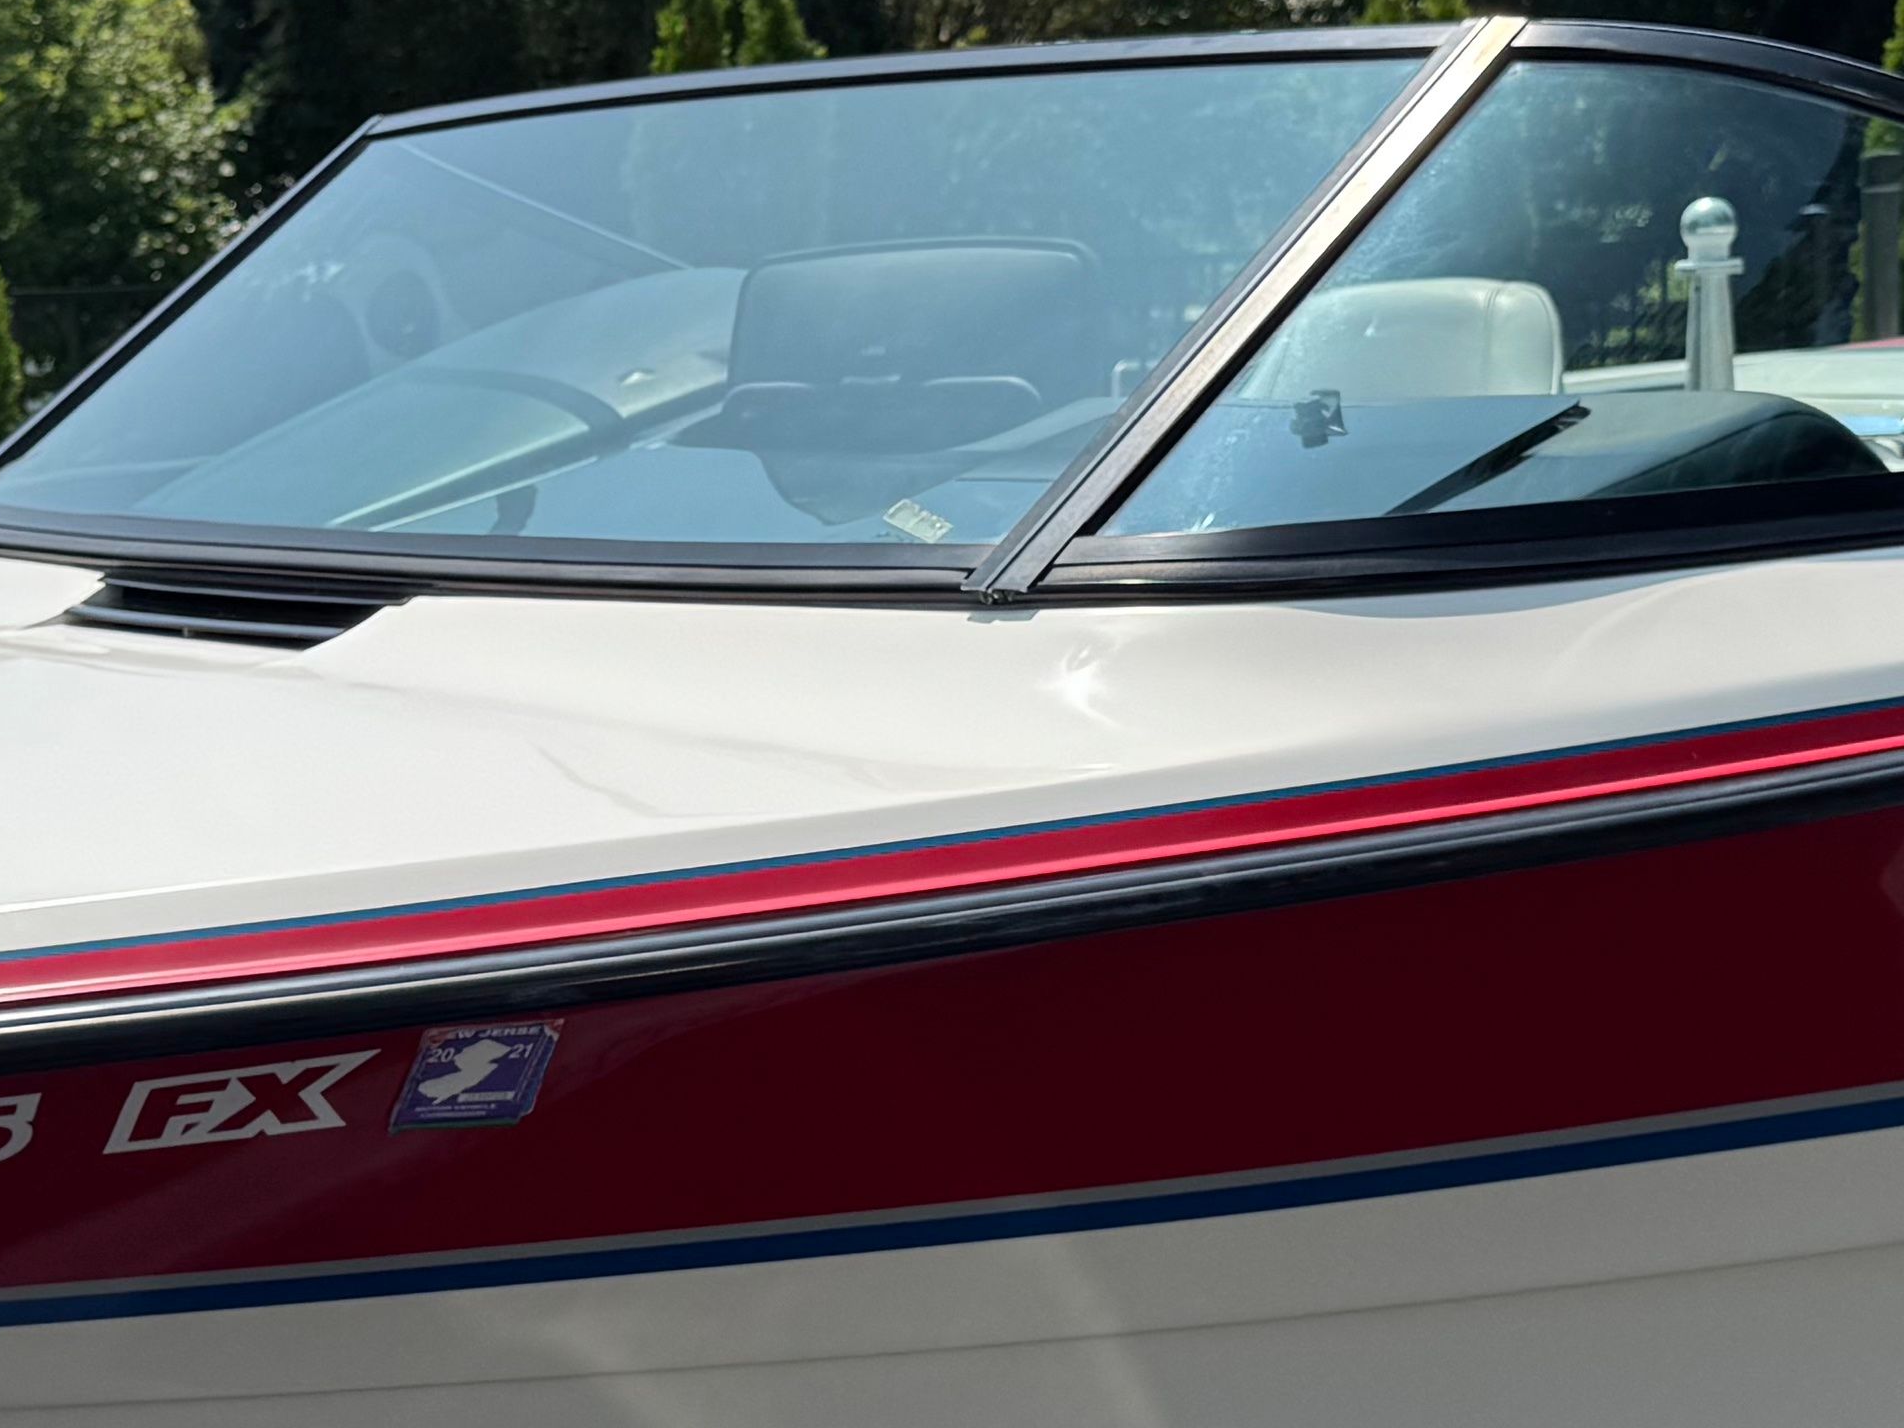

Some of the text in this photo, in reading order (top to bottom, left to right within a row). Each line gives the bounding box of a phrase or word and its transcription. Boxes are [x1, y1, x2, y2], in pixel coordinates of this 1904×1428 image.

[426, 1042, 535, 1064] 20 21
[103, 1049, 381, 1155] FX
